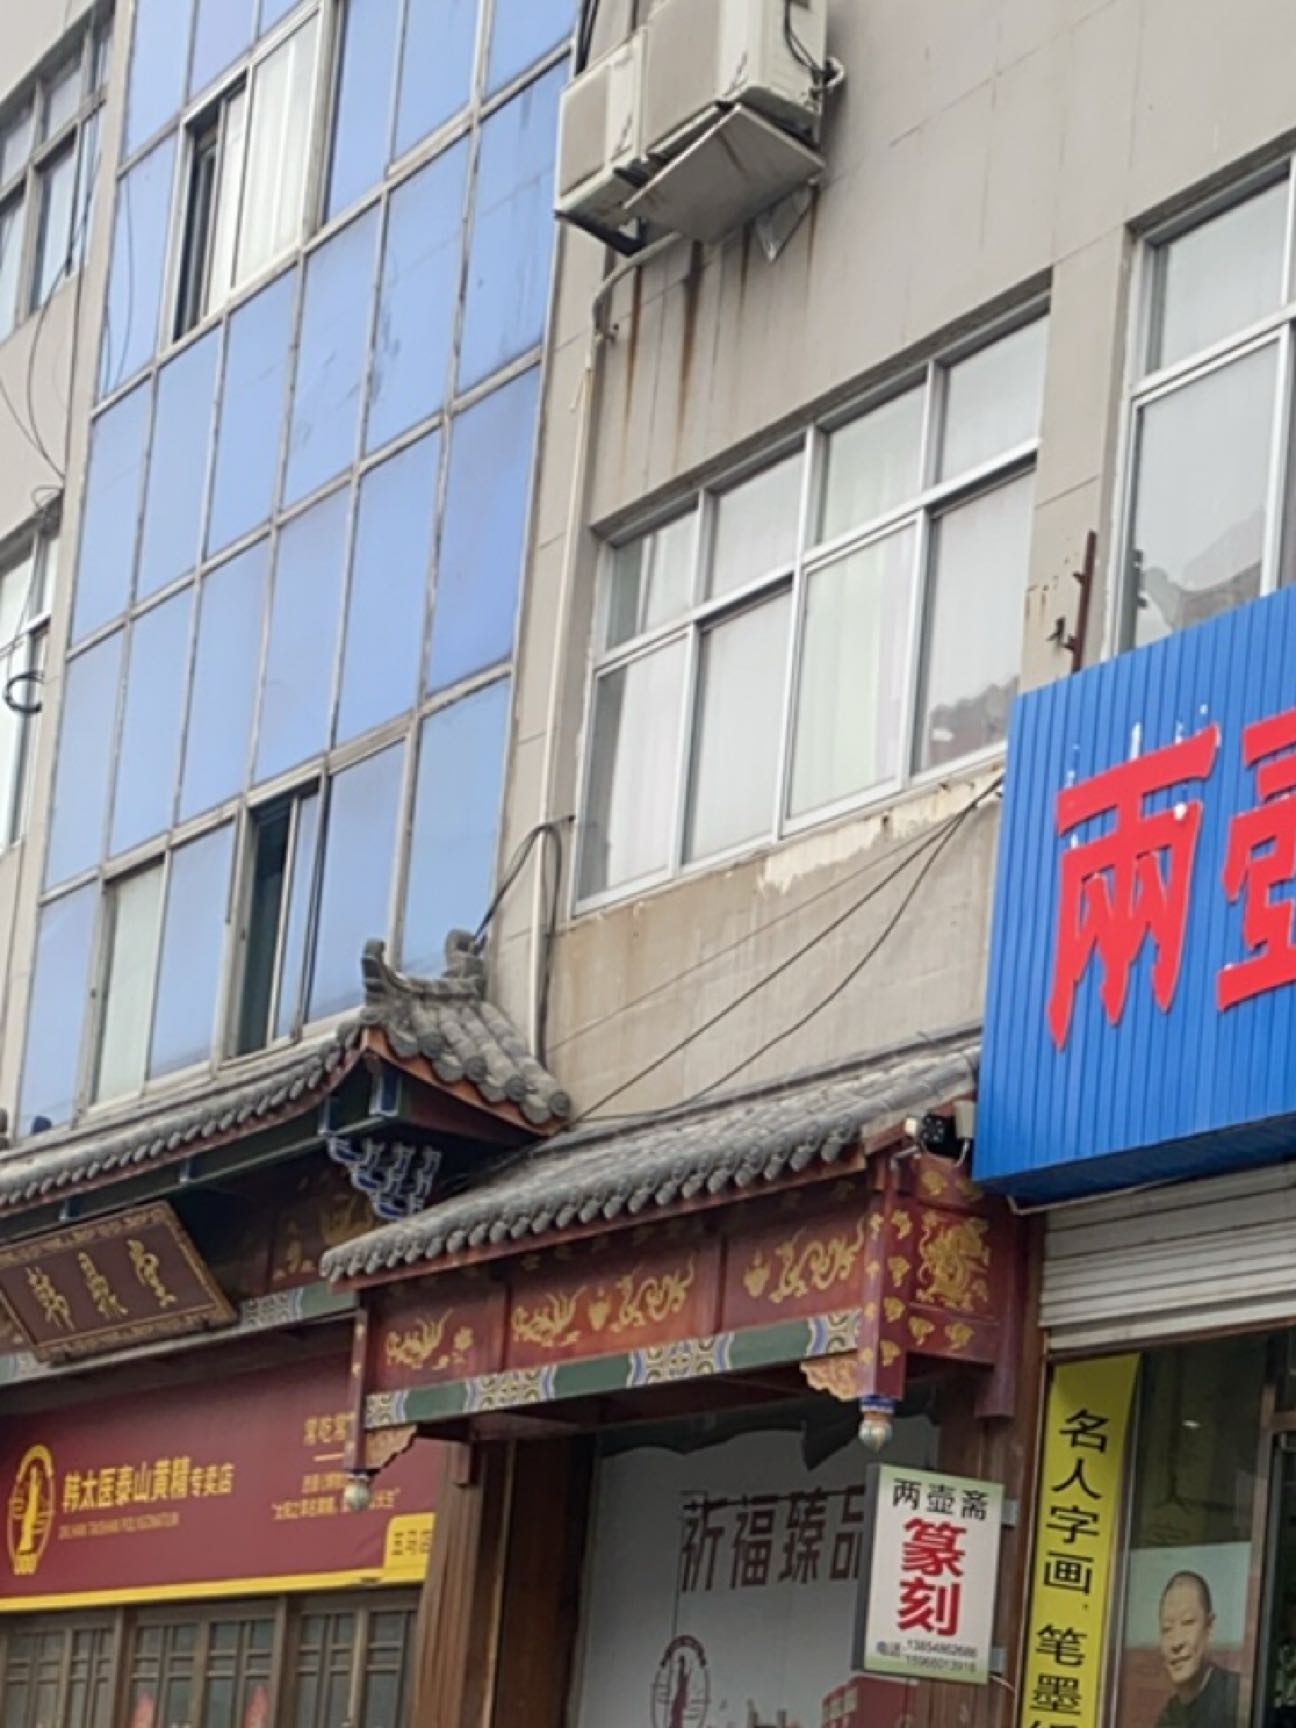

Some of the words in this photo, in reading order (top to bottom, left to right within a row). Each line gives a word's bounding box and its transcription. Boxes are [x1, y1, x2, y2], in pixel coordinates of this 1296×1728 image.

[892, 1477, 989, 1522] 两壶斋
[1043, 1407, 1110, 1596] 名人字画
[897, 1517, 968, 1637] 篆刻
